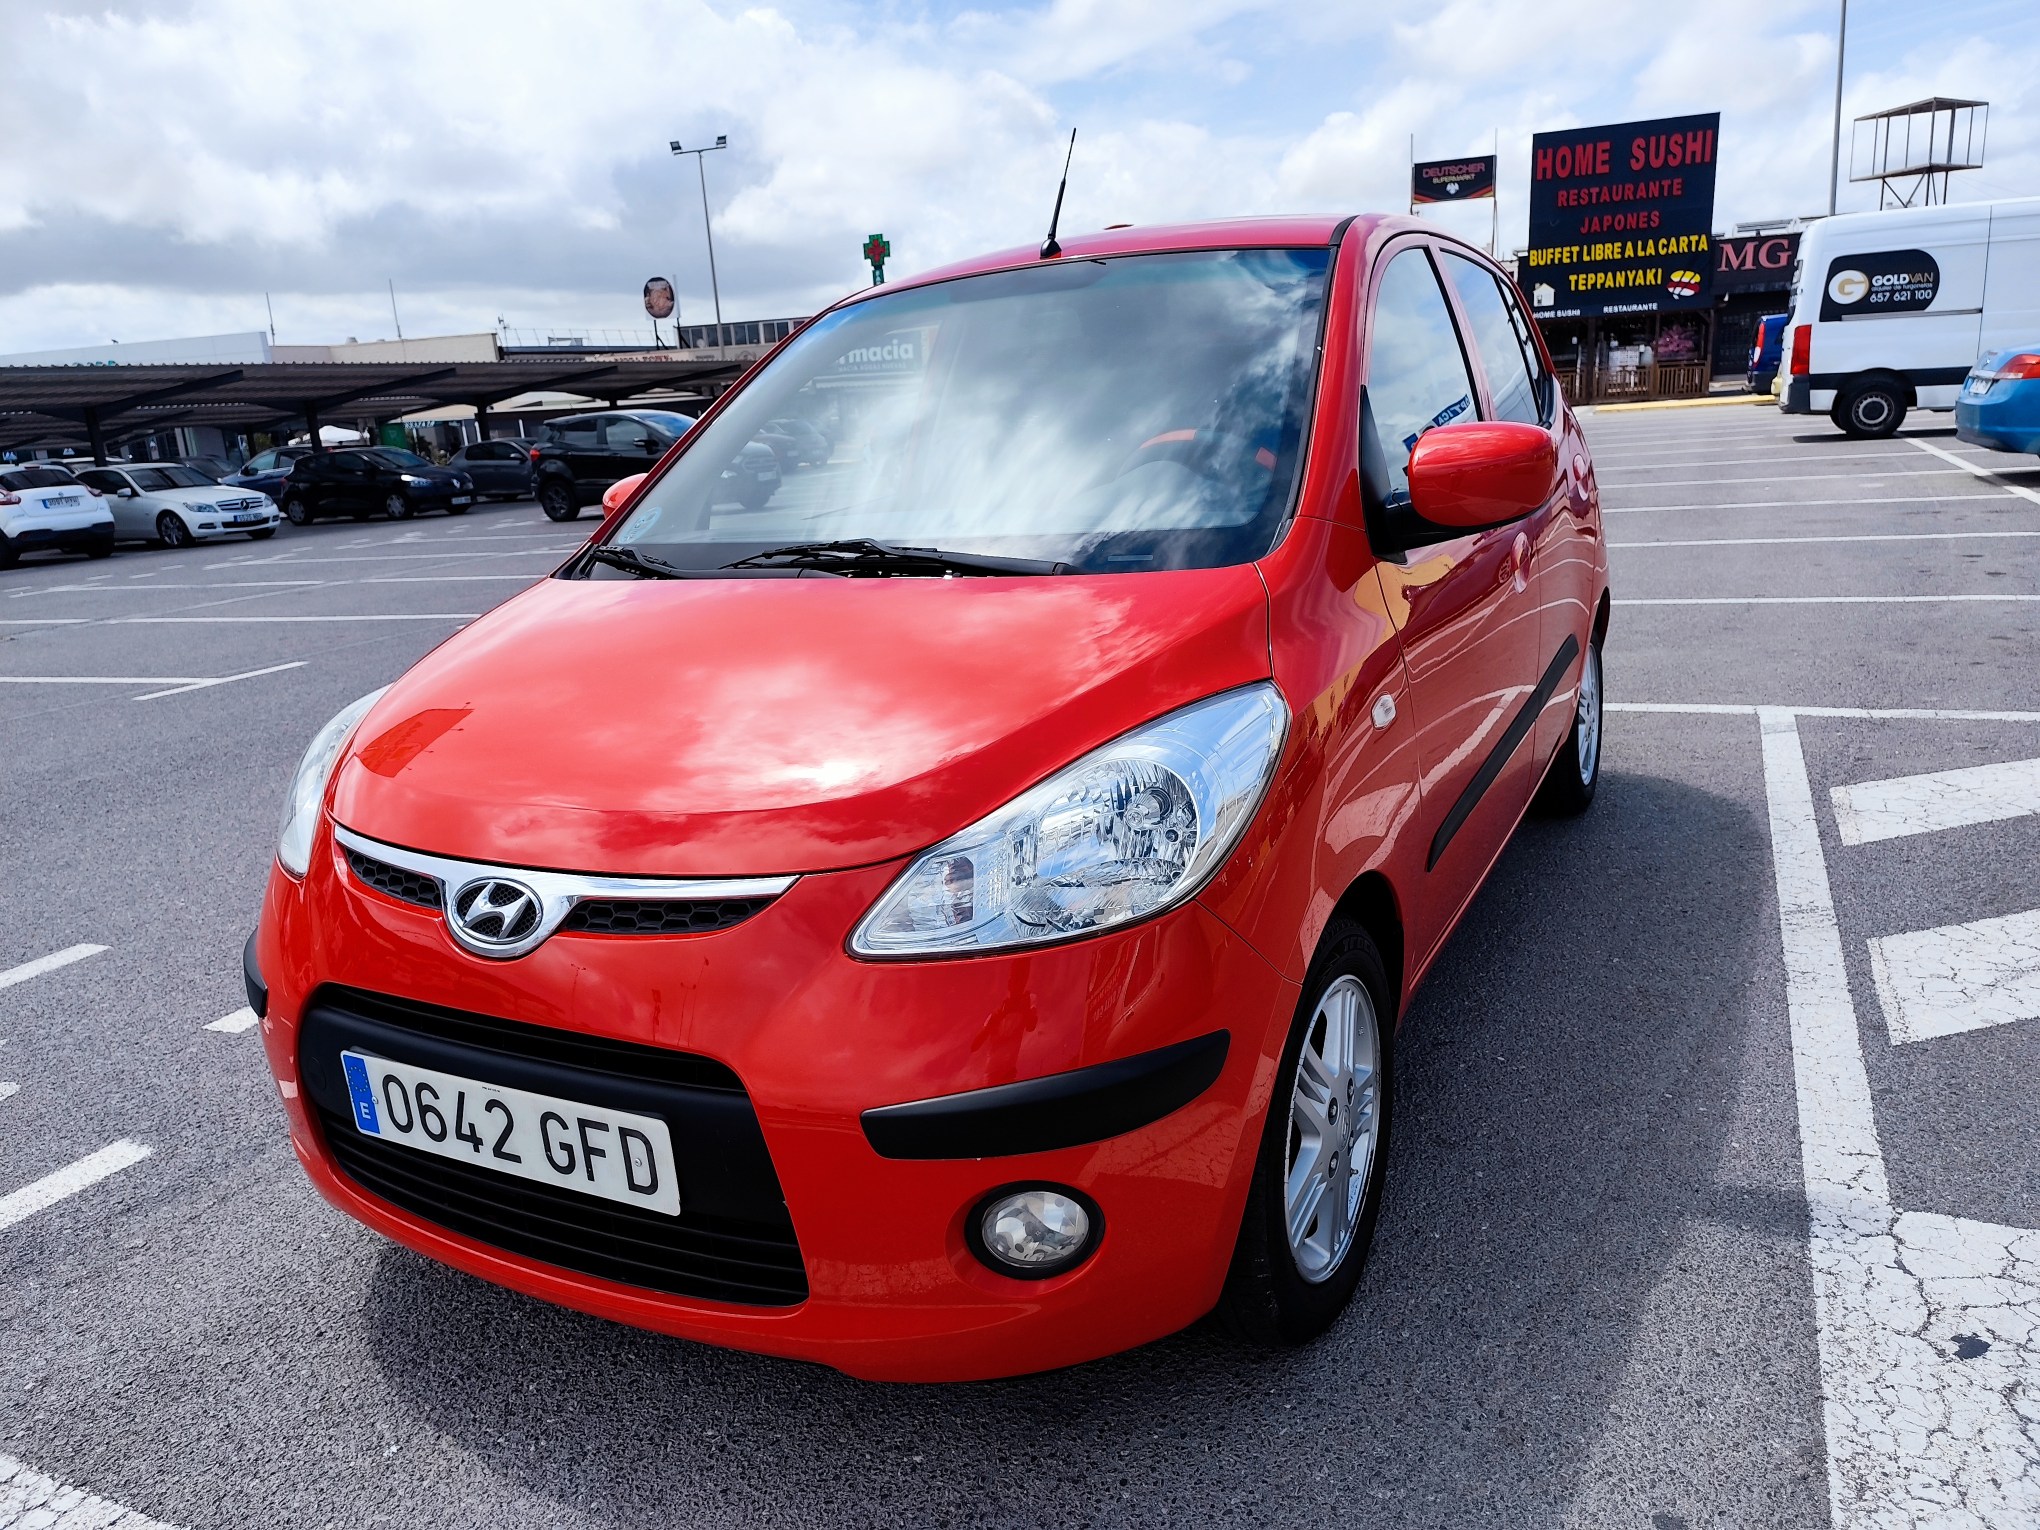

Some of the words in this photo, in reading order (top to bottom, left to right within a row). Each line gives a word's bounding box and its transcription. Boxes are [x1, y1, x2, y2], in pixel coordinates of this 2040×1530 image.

[1537, 141, 1611, 180] HOME
[1630, 130, 1713, 171] SUSHI
[1423, 162, 1485, 178] DEUTSCHER
[1557, 177, 1683, 207] RESTAURANTE
[1580, 210, 1661, 234] JAPONES
[1529, 245, 1580, 267] BUFFET
[1583, 241, 1622, 262] LIBRE
[1624, 240, 1635, 259] A
[1637, 238, 1656, 257] LA
[1658, 234, 1709, 256] CARTA
[1717, 238, 1792, 272] MG
[1569, 268, 1663, 291] TEPPANYAKI
[1870, 292, 1891, 303] 657
[1893, 291, 1911, 302] 621
[1915, 289, 1932, 300] 100
[1533, 310, 1555, 319] HOME
[1557, 309, 1580, 318] SUSHI
[1603, 303, 1658, 314] RESTAURANTE
[360, 1102, 371, 1119] E
[382, 1074, 522, 1163] 0642
[539, 1111, 658, 1195] GFD
